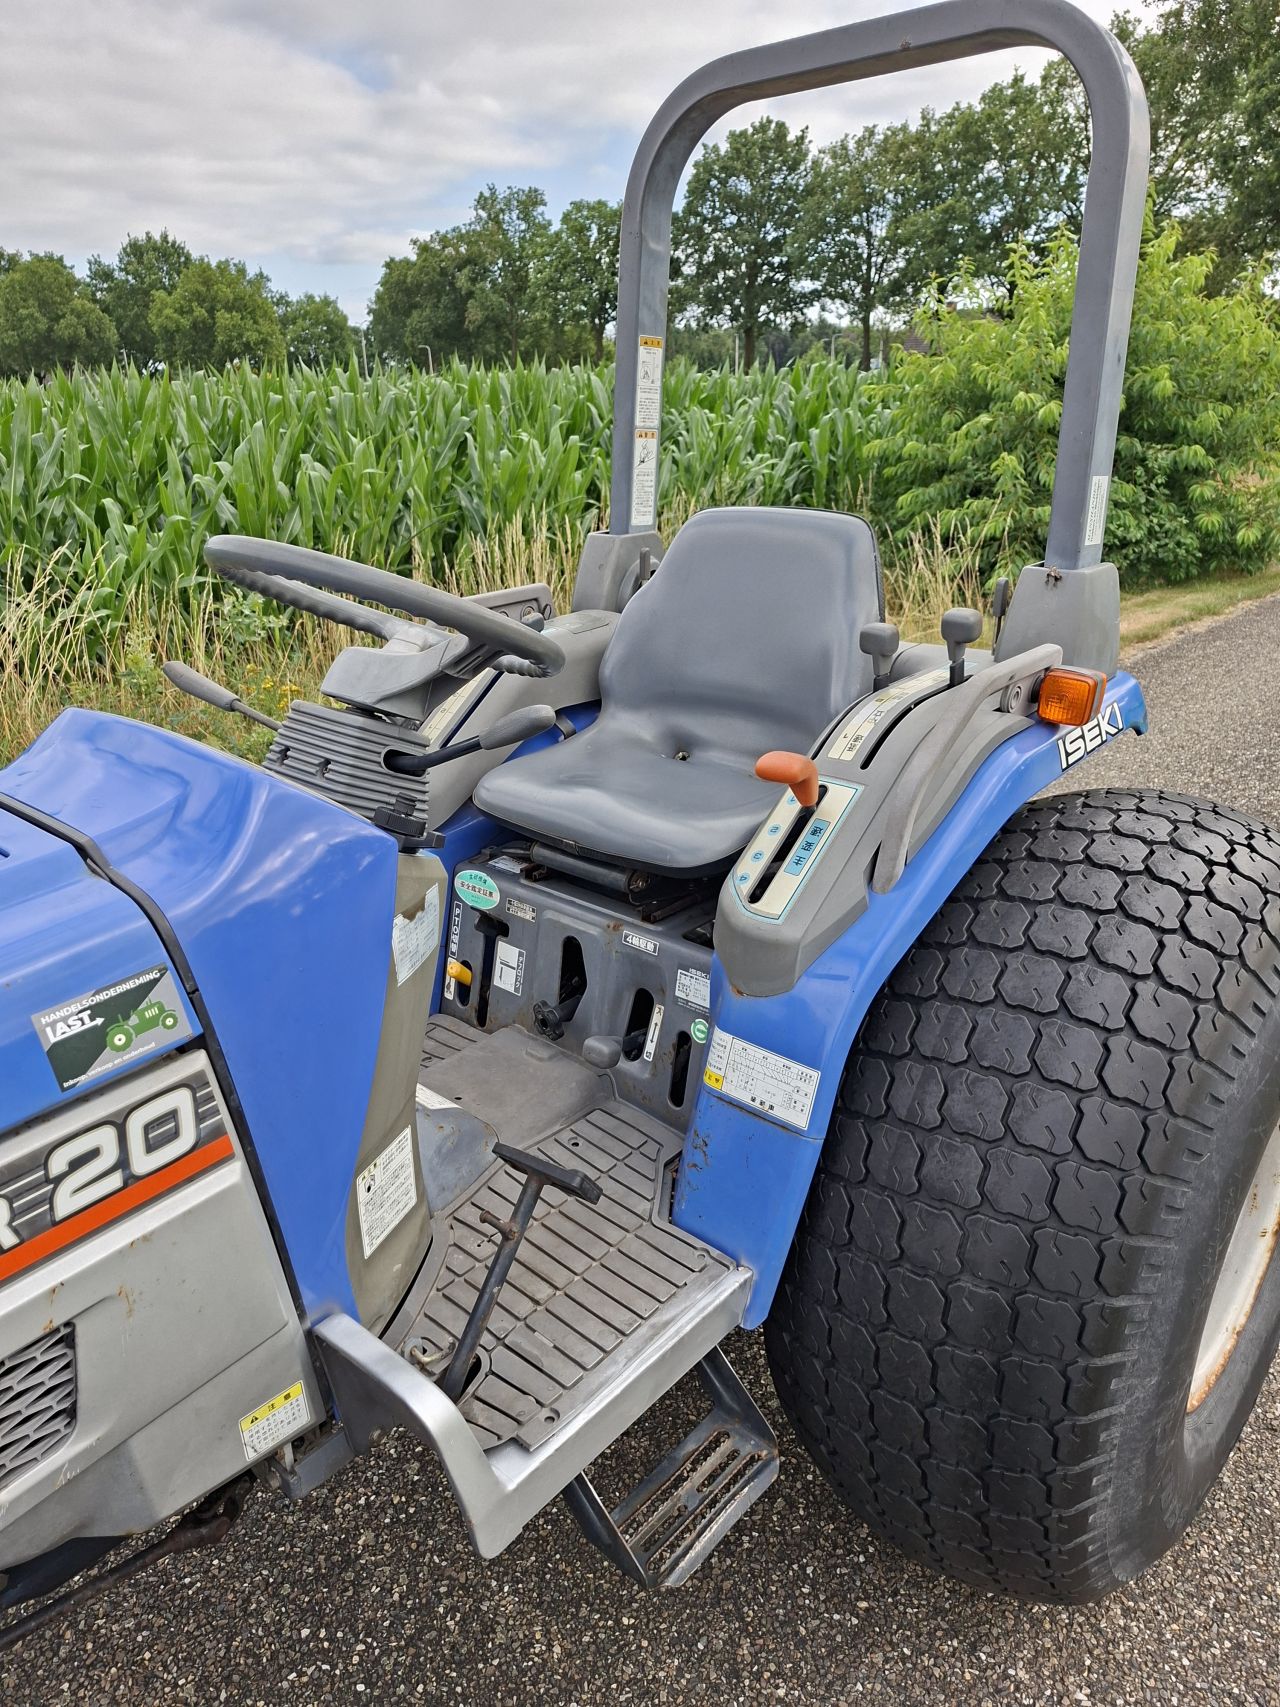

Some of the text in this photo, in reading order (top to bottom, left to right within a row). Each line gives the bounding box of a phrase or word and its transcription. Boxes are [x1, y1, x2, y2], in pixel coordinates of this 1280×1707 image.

[1058, 702, 1124, 771] ISEKI
[793, 825, 823, 867] 主変速
[40, 969, 161, 1025] HANDELSONDERNEMING
[45, 1009, 97, 1044] LAST
[48, 1087, 197, 1221] 20
